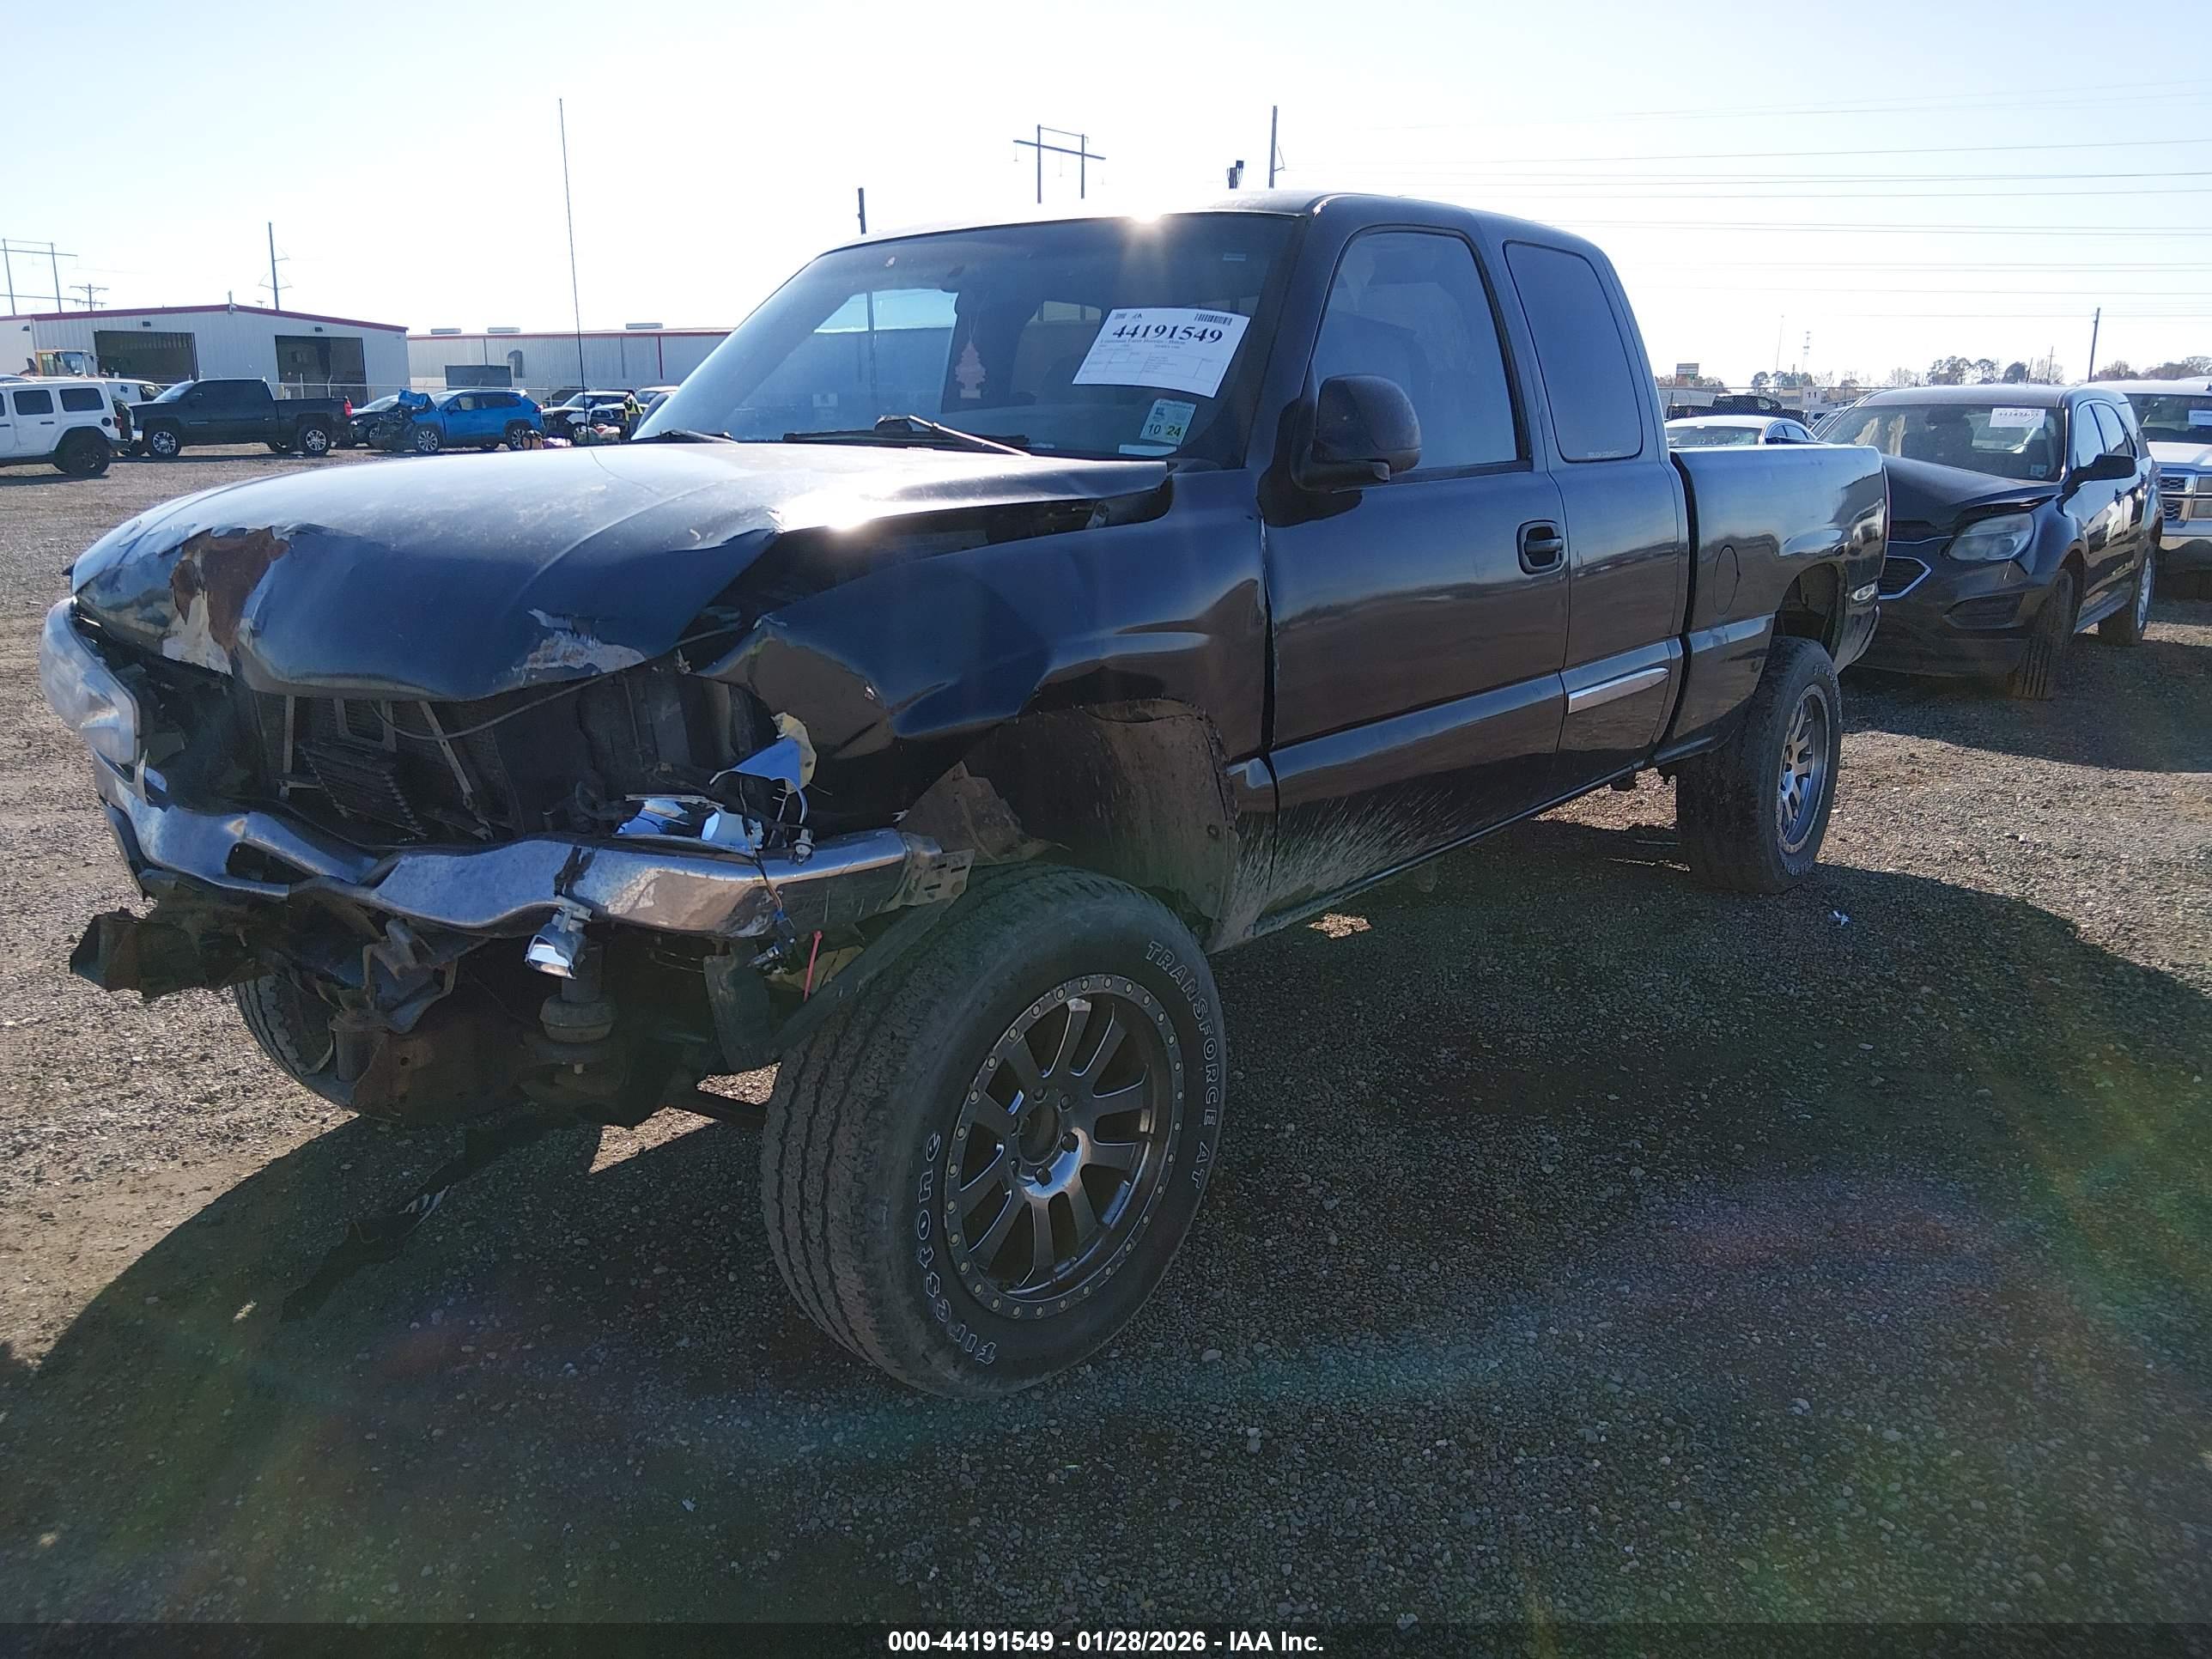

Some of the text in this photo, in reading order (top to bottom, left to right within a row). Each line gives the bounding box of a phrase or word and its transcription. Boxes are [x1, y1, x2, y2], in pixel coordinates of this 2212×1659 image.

[1113, 324, 1224, 344] 44191549
[1148, 423, 1182, 437] 10 24
[1146, 940, 1219, 1189] TRANSFORCE AT
[916, 1133, 997, 1365] Firestone
